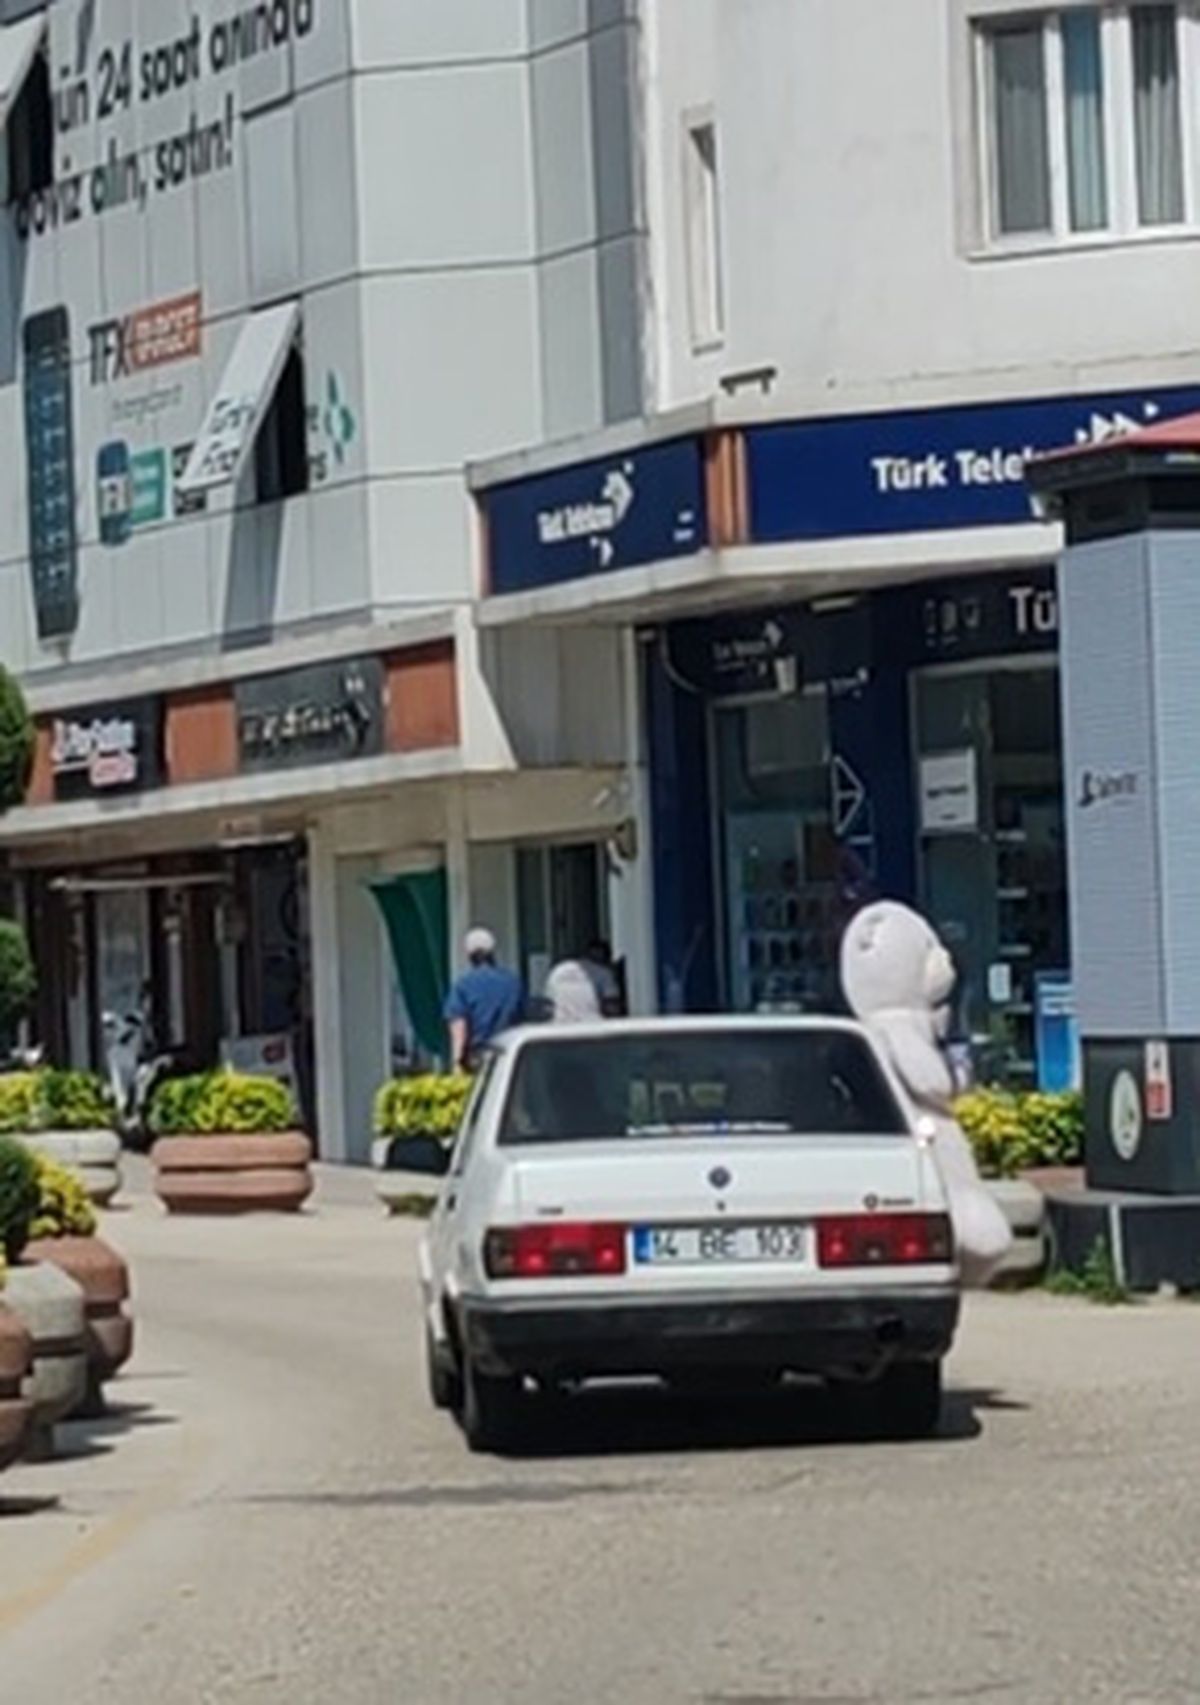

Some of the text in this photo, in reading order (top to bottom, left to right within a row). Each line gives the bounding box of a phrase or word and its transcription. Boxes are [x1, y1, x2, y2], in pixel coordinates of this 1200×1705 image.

[97, 41, 131, 120] 24
[140, 15, 200, 102] saat
[871, 446, 1040, 493] Türk Tele
[1009, 586, 1057, 634] Tü
[654, 1227, 679, 1258] 14
[756, 1224, 801, 1256] 103
